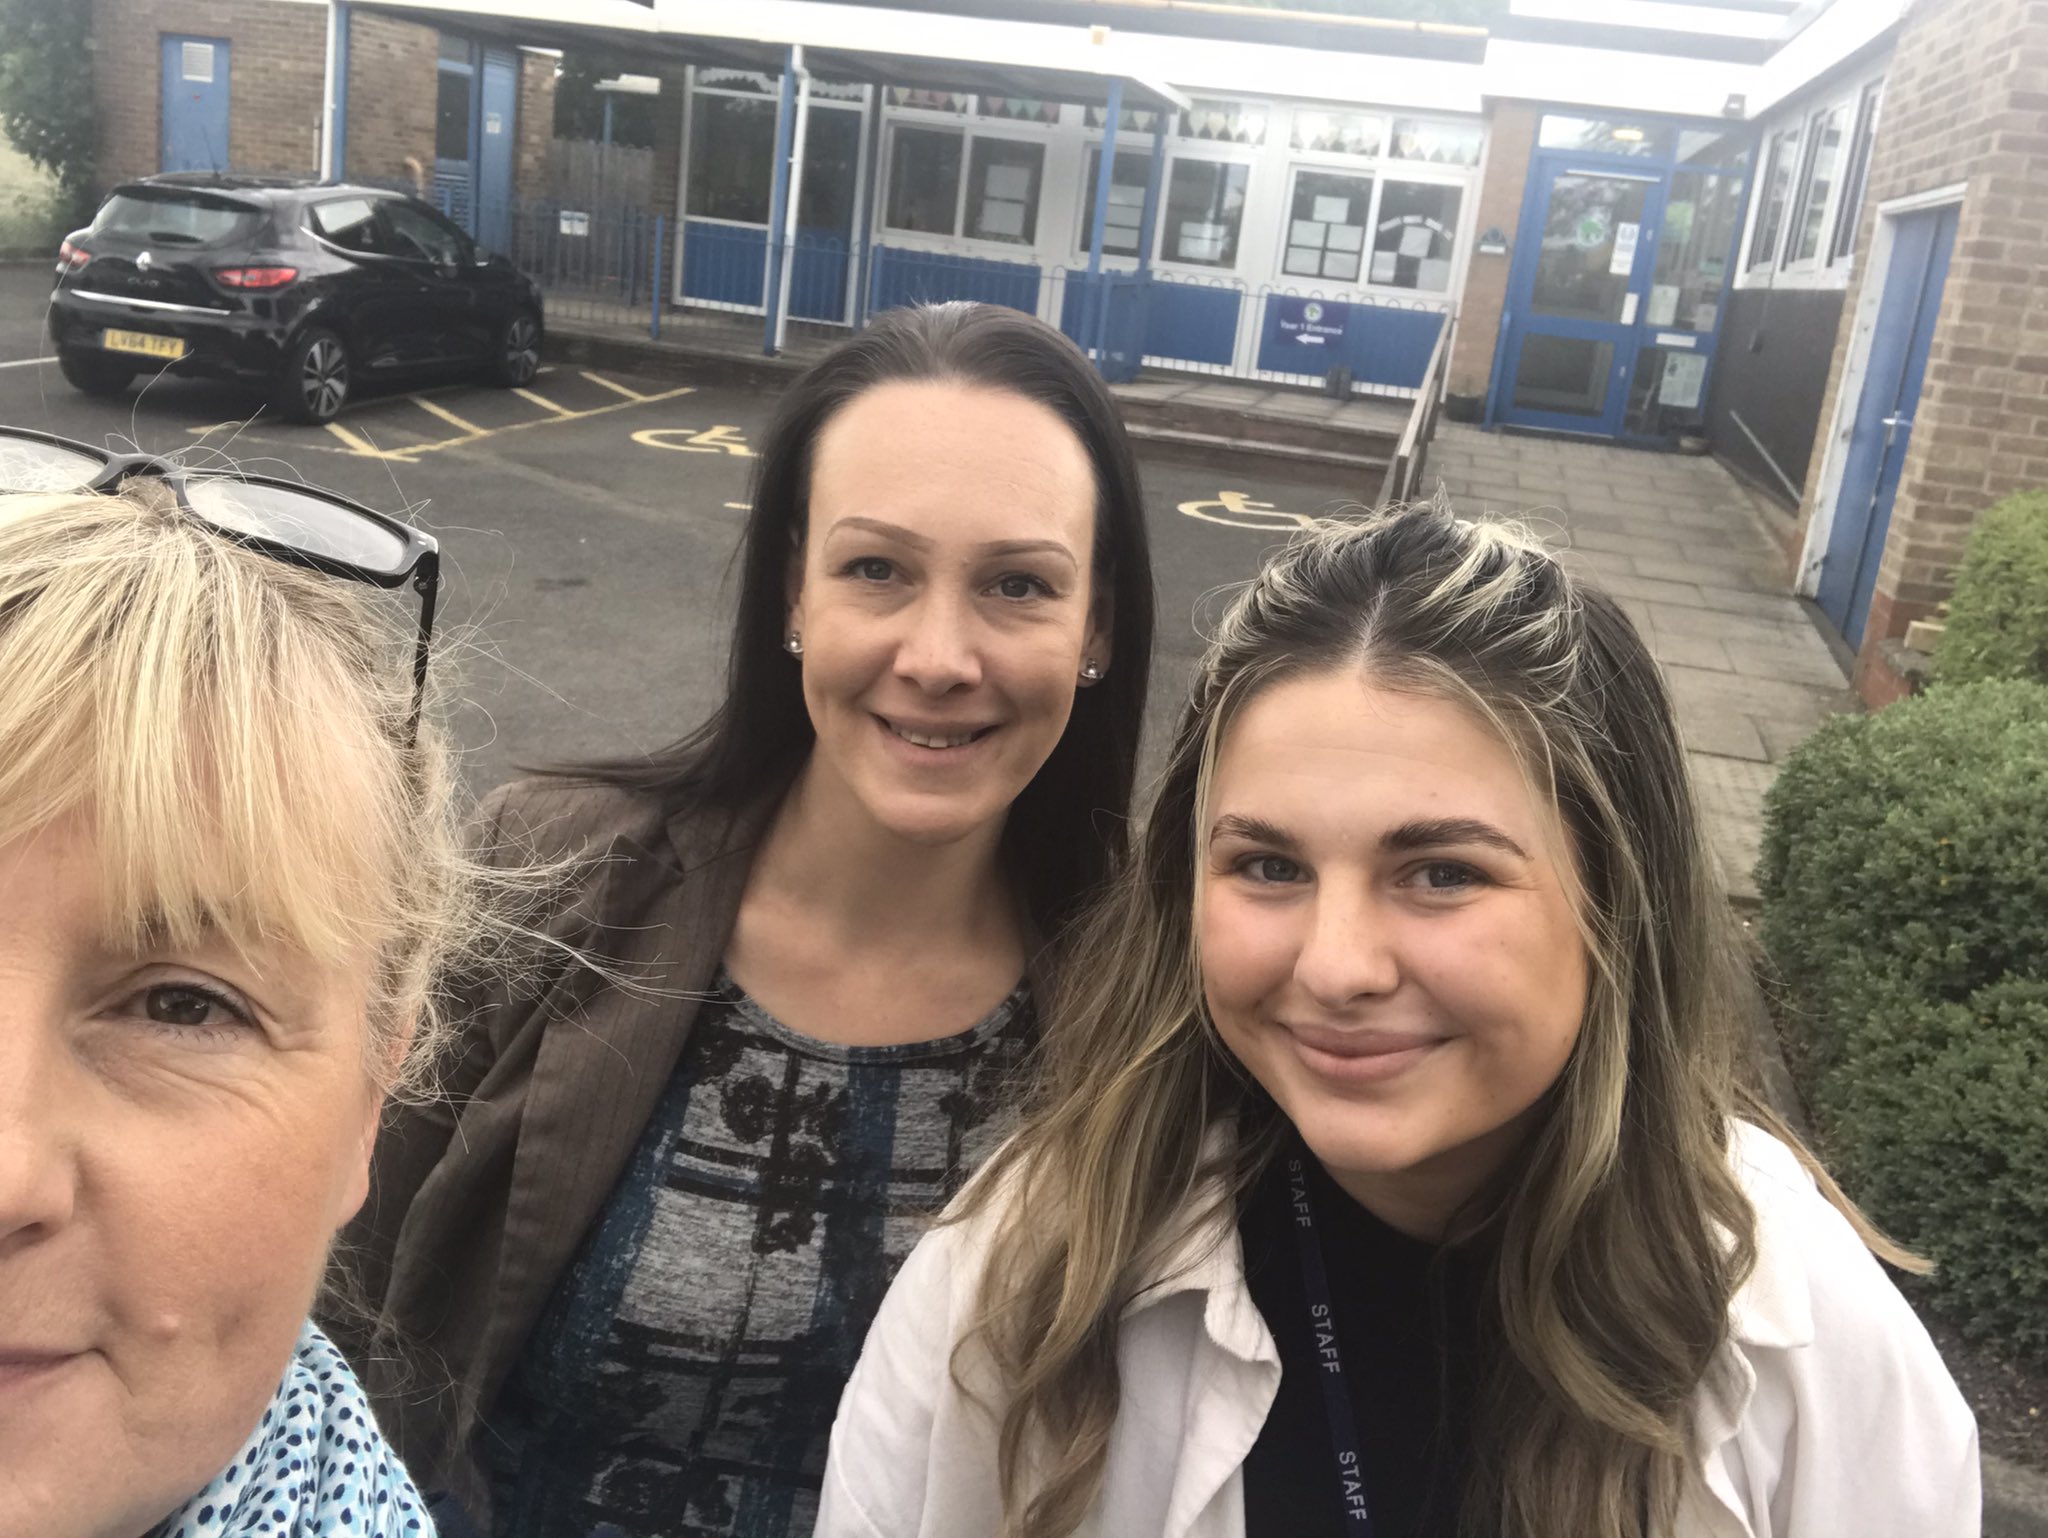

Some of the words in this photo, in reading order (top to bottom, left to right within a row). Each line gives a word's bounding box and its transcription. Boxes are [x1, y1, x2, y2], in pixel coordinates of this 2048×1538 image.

[110, 331, 145, 349] LV64
[1289, 1159, 1312, 1227] STAFF
[1311, 1304, 1341, 1373] STAFF
[1339, 1451, 1367, 1520] STAFF
